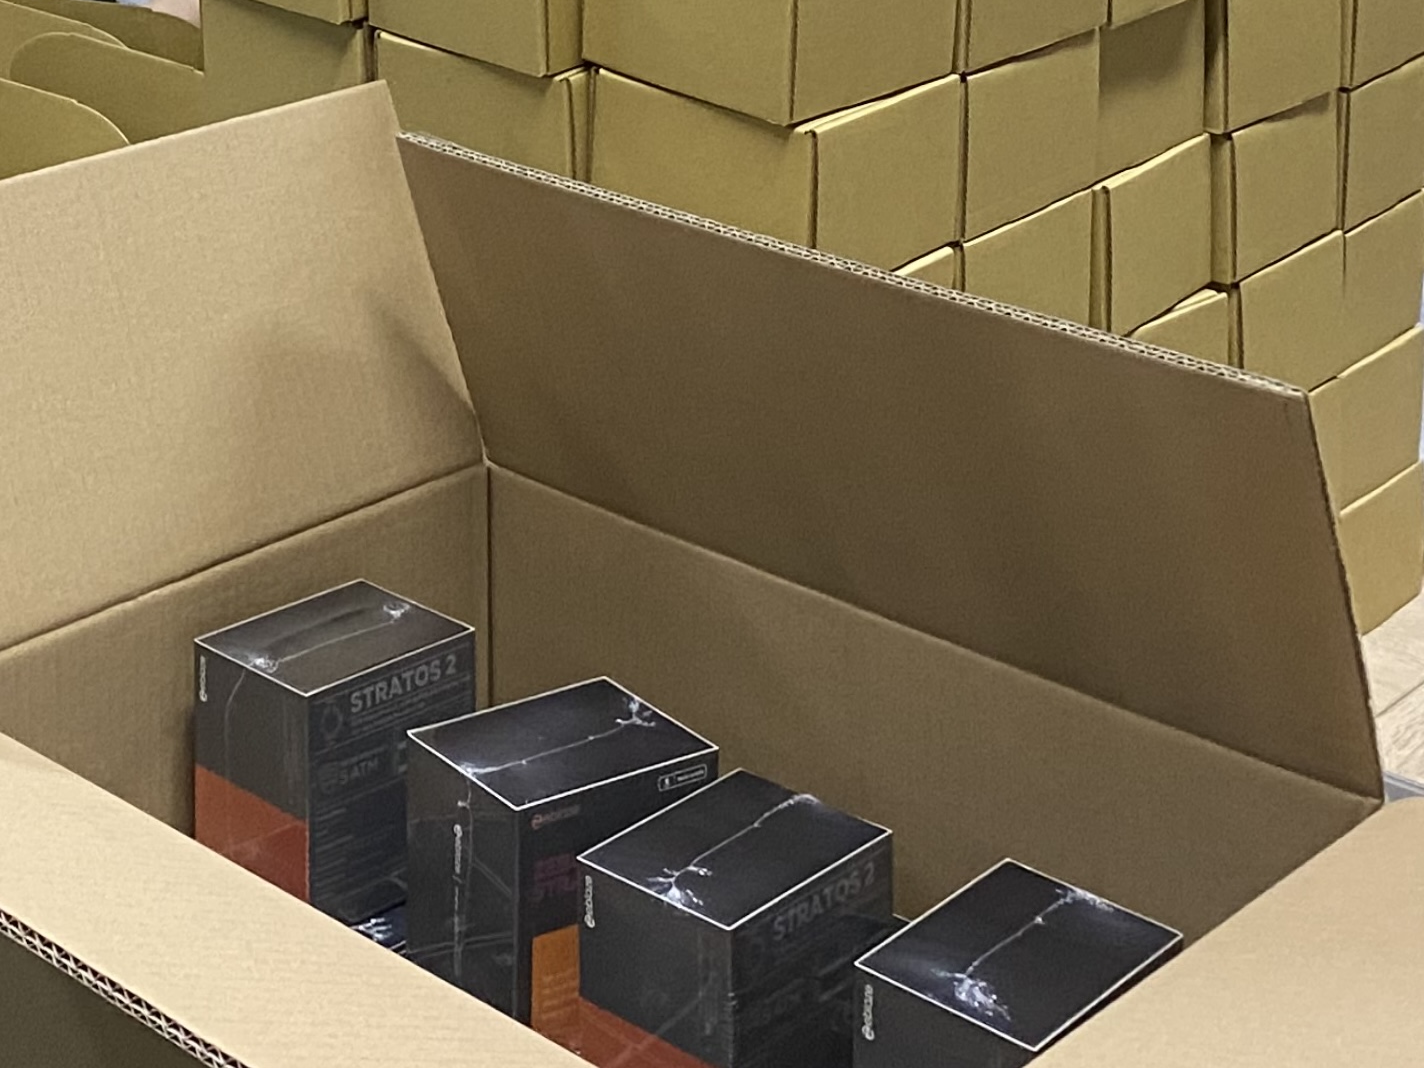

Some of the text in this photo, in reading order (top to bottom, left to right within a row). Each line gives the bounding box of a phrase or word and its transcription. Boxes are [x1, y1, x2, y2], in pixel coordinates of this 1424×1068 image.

[350, 659, 442, 713] STRATOS
[445, 654, 456, 675] 2
[773, 861, 875, 941] STRATOS 2
